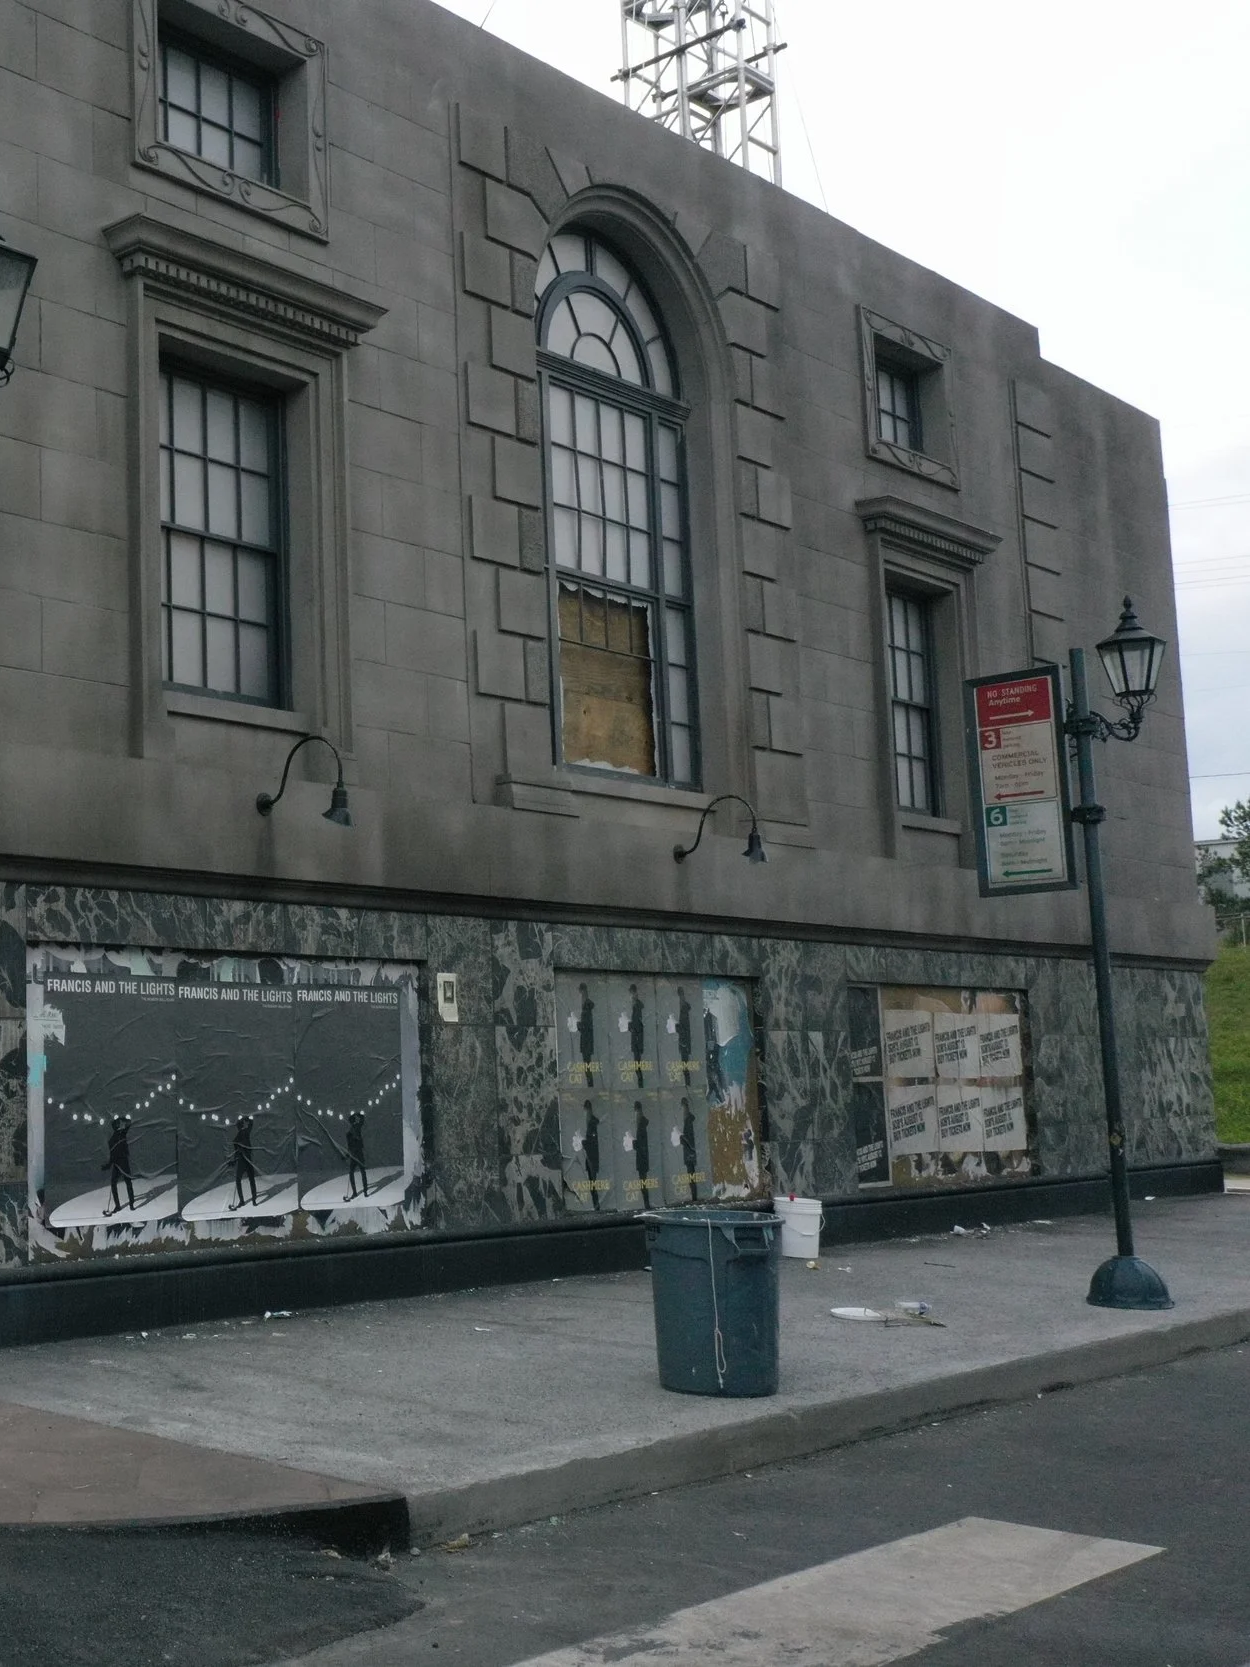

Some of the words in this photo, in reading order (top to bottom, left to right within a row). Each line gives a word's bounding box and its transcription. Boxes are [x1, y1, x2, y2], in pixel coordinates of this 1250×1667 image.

[987, 690, 998, 699] NO
[1002, 684, 1037, 697] STANDING
[988, 696, 1021, 708] Anytime
[983, 730, 996, 748] 3
[992, 751, 1039, 761] COMMERCIAL
[993, 759, 1026, 769] VEHICLES
[1029, 757, 1047, 765] ONLY
[990, 808, 1003, 825] 6
[47, 979, 92, 993] FRANCIS
[94, 980, 116, 994] AND
[118, 981, 138, 995] THE
[140, 982, 175, 996] LIGHTS
[178, 986, 218, 1001] FRANCIS
[220, 988, 240, 1001] AND
[242, 988, 259, 1002] THE
[261, 989, 293, 1003] LIGHTS
[296, 989, 332, 1002] FRANCIS
[334, 990, 351, 1003] AND
[353, 991, 368, 1003] THE
[370, 991, 398, 1005] LIGHTS
[569, 1073, 583, 1084] CAT
[620, 1071, 634, 1082] CAT
[622, 1177, 659, 1190] CASHMERE
[672, 1172, 706, 1185] CASHMERE
[626, 1191, 639, 1202] CAT
